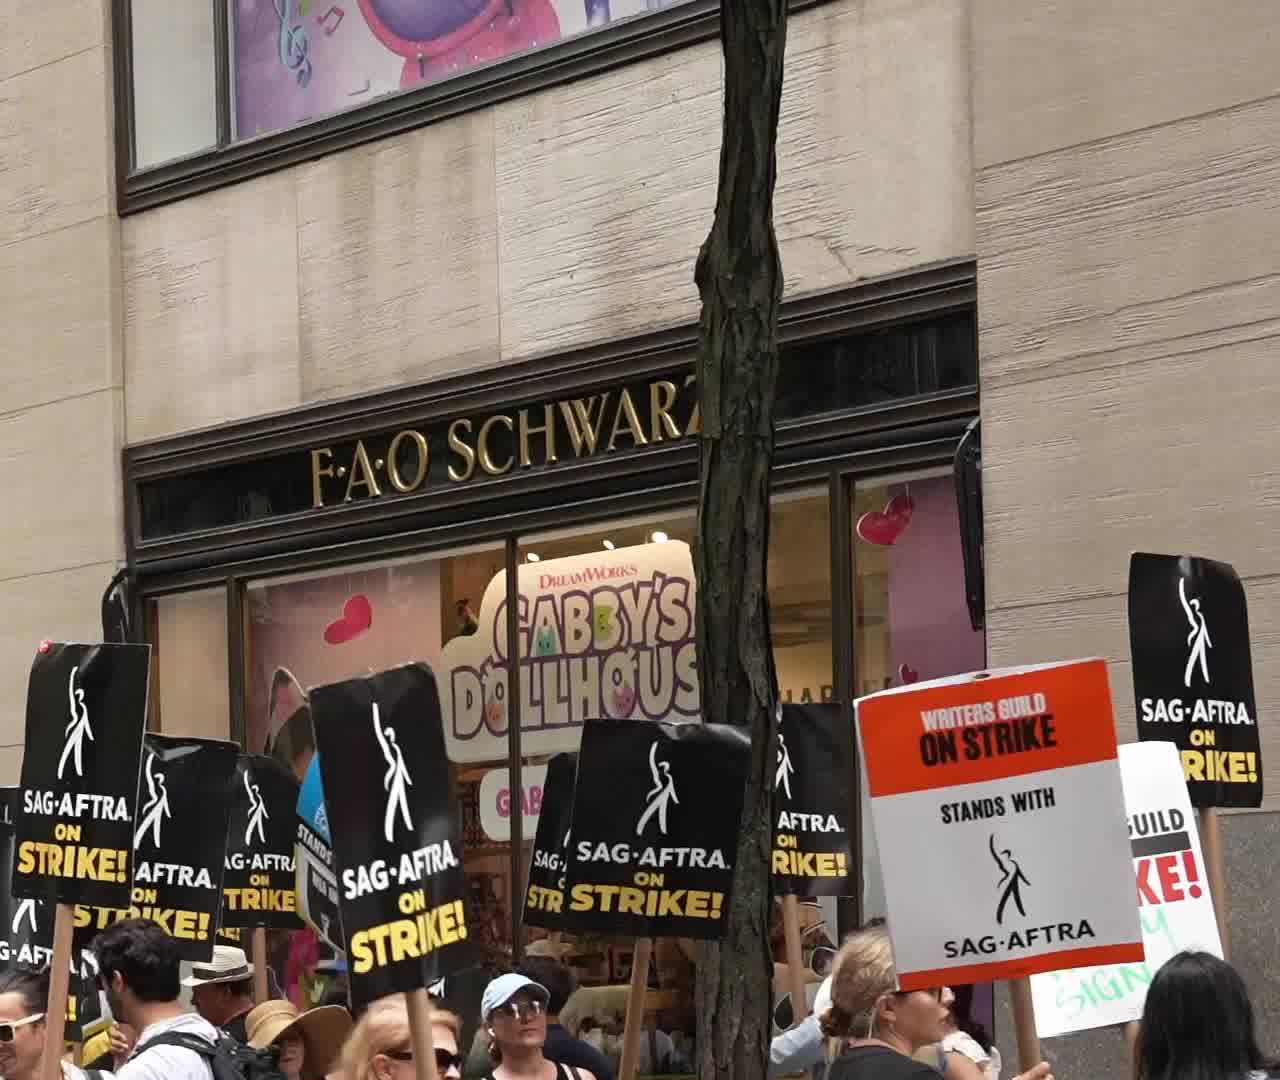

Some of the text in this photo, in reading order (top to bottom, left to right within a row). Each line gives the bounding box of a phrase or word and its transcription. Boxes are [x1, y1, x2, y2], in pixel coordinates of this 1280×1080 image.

[450, 641, 704, 741] DOLLHOUS
[920, 693, 1047, 733] WRITERS GUILD
[920, 714, 1057, 768] ON STRIKE
[1190, 729, 1215, 747] ON
[1182, 750, 1258, 783] RIKE!
[940, 786, 1056, 825] STANDS WITH
[55, 824, 82, 843] ON
[777, 834, 798, 850] ON
[17, 841, 129, 883] STRIKE!
[771, 850, 848, 878] RIKE!
[250, 873, 271, 887] ON
[634, 872, 665, 888] ON
[131, 888, 158, 905] ON
[223, 887, 297, 913] TRIKE
[398, 889, 426, 915] ON
[569, 882, 725, 920] STRIKE!
[350, 899, 468, 975] STRIKE!
